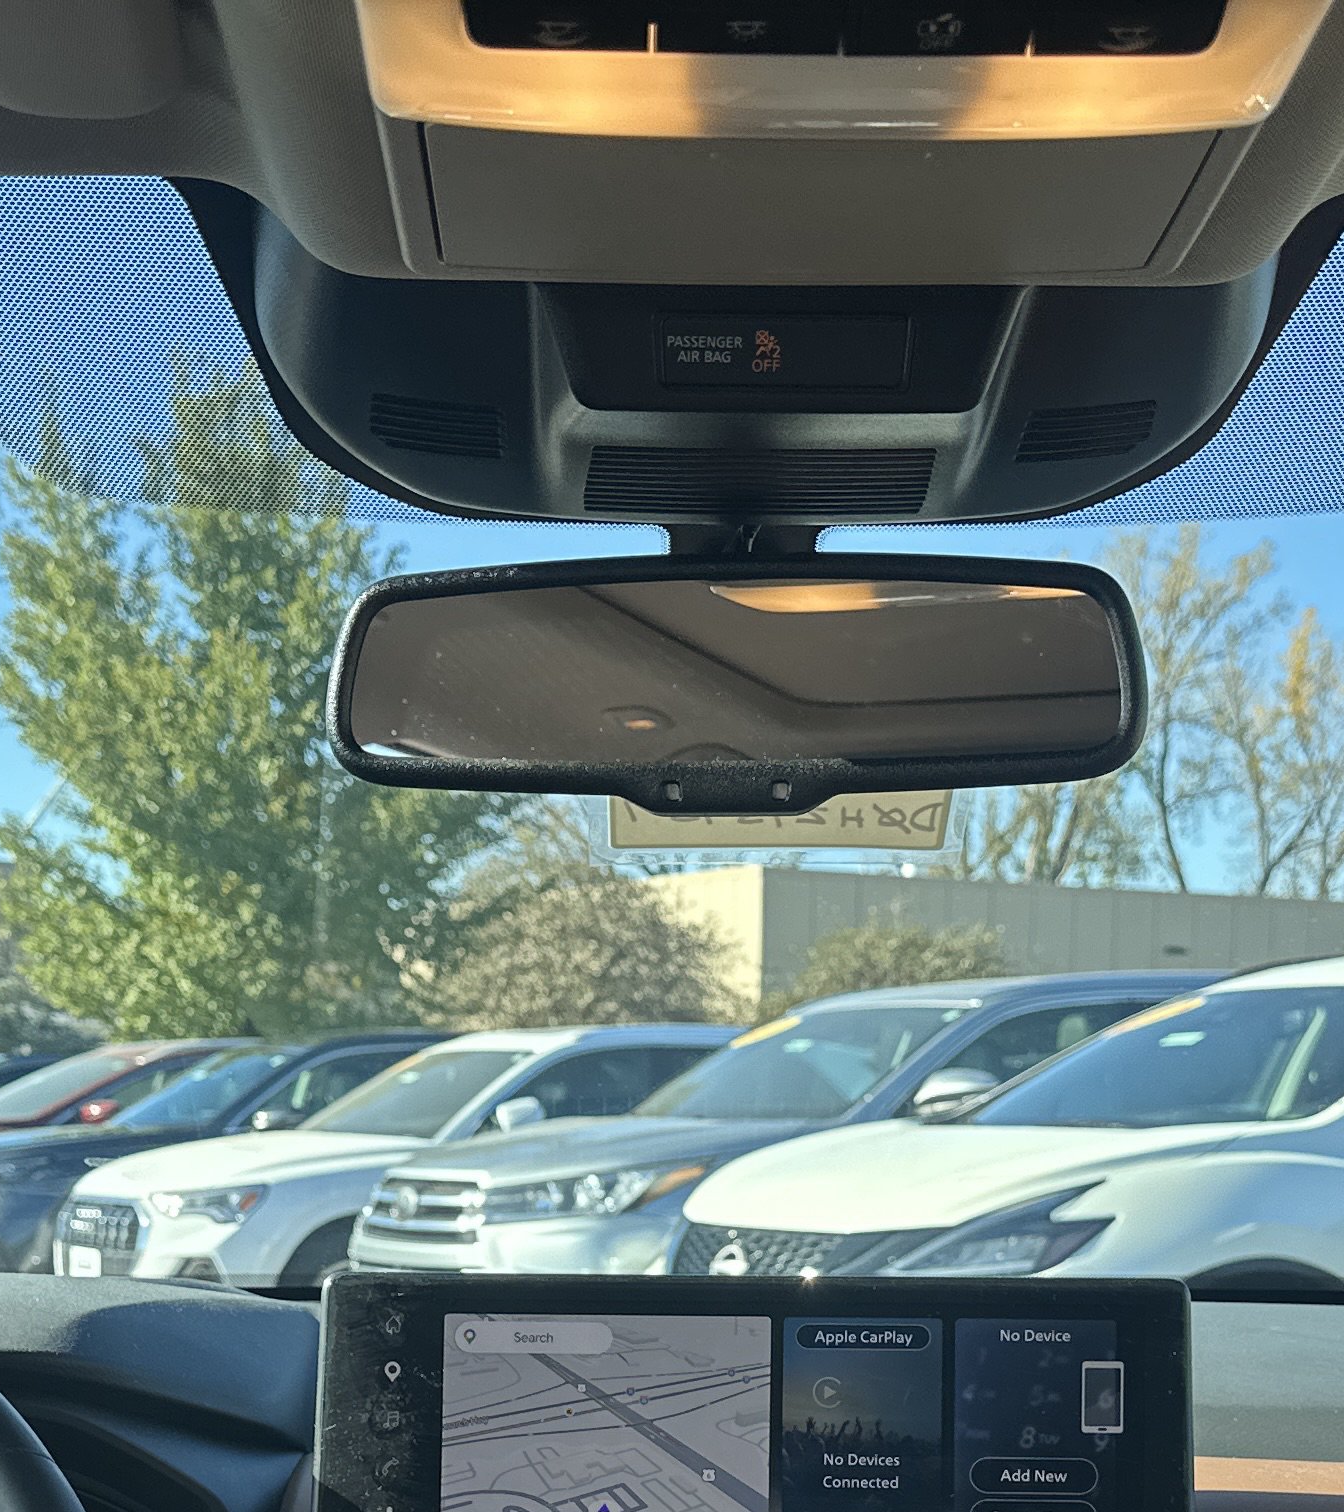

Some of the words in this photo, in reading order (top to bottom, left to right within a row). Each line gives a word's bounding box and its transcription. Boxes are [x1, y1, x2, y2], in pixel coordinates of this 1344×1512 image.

[667, 335, 743, 348] PASSENGER
[677, 351, 700, 362] AIR
[704, 351, 732, 363] BAG
[752, 359, 781, 372] OFF
[513, 1332, 554, 1344] Search
[814, 1330, 857, 1345] Apple
[860, 1331, 913, 1346] CarPlay
[1000, 1330, 1020, 1342] No
[1023, 1330, 1071, 1342] Device
[823, 1454, 844, 1466] No
[847, 1454, 900, 1466] Devices
[823, 1476, 899, 1489] Connected
[1000, 1469, 1030, 1482] Add
[1034, 1470, 1068, 1483] New
